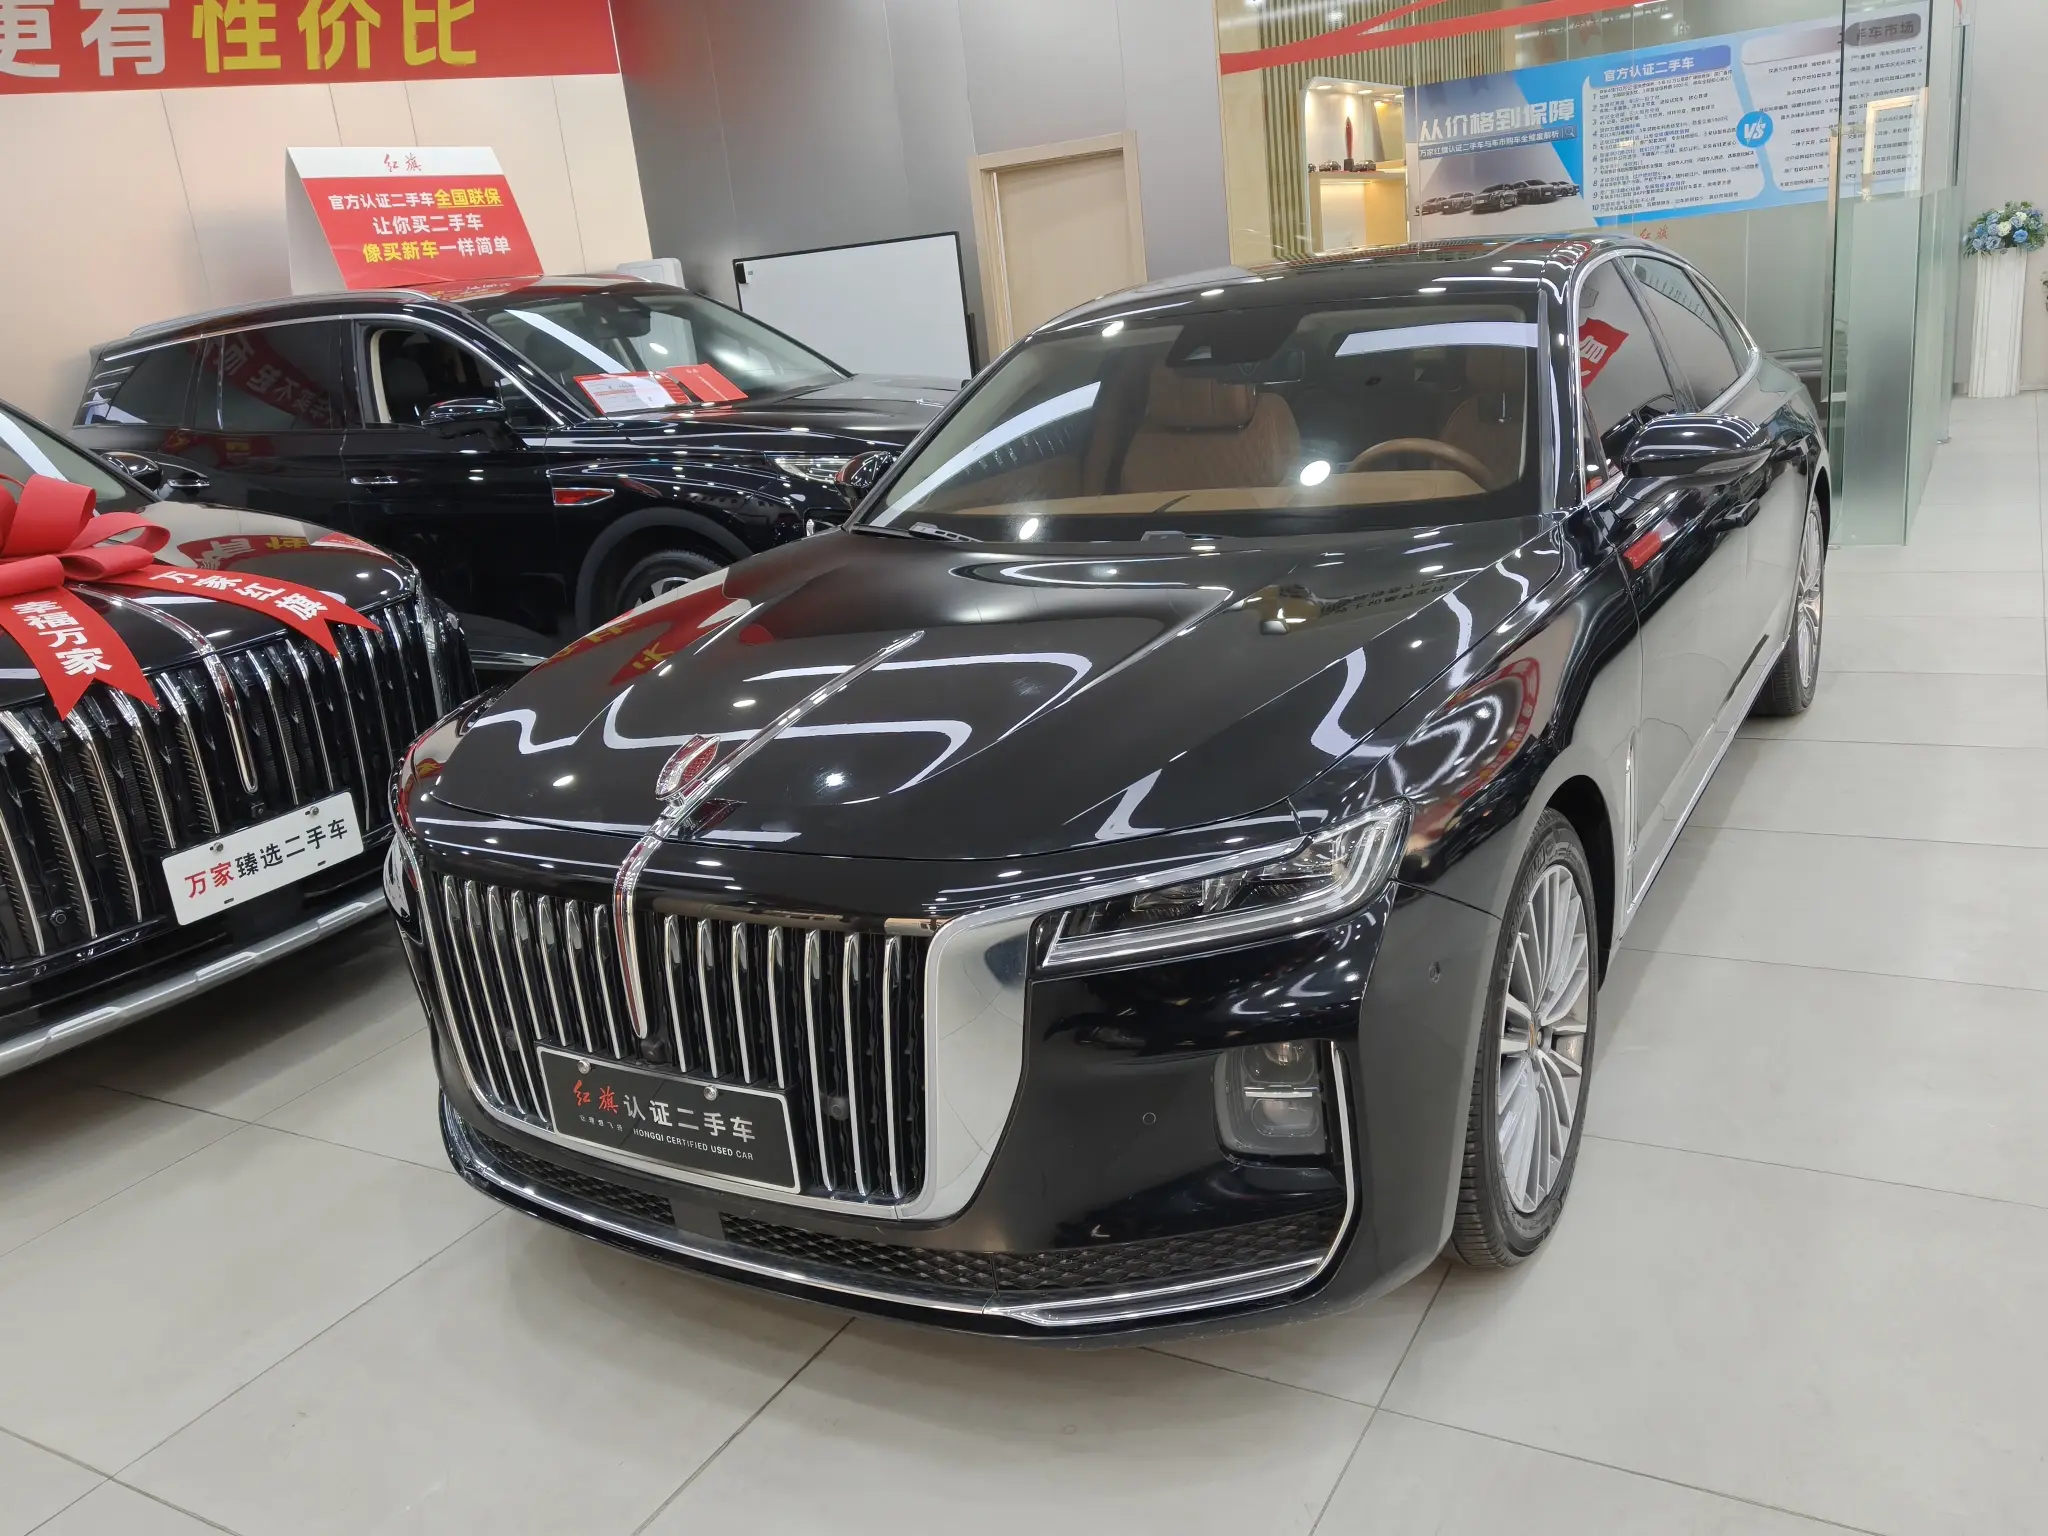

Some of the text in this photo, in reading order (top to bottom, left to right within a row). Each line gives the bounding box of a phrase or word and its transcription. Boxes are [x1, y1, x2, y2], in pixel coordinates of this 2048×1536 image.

[0, 0, 477, 79] 更有性价比
[1603, 57, 1695, 83] 官方认证二手车
[1419, 99, 1575, 142] 从价格到保障
[1743, 121, 1766, 140] VS
[384, 153, 423, 172] 红旗
[328, 187, 503, 211] 官方认证二手车全国联保
[372, 213, 484, 236] 让你买二手车
[1640, 224, 1669, 240] 红旗
[362, 235, 512, 264] 像买新车一样简单
[149, 570, 328, 621] 万家红旗
[11, 600, 113, 676] 幸福万家
[184, 818, 349, 899] 万家臻选二手车
[633, 1128, 754, 1161] HONGQI CERTIFIED USED CAR
